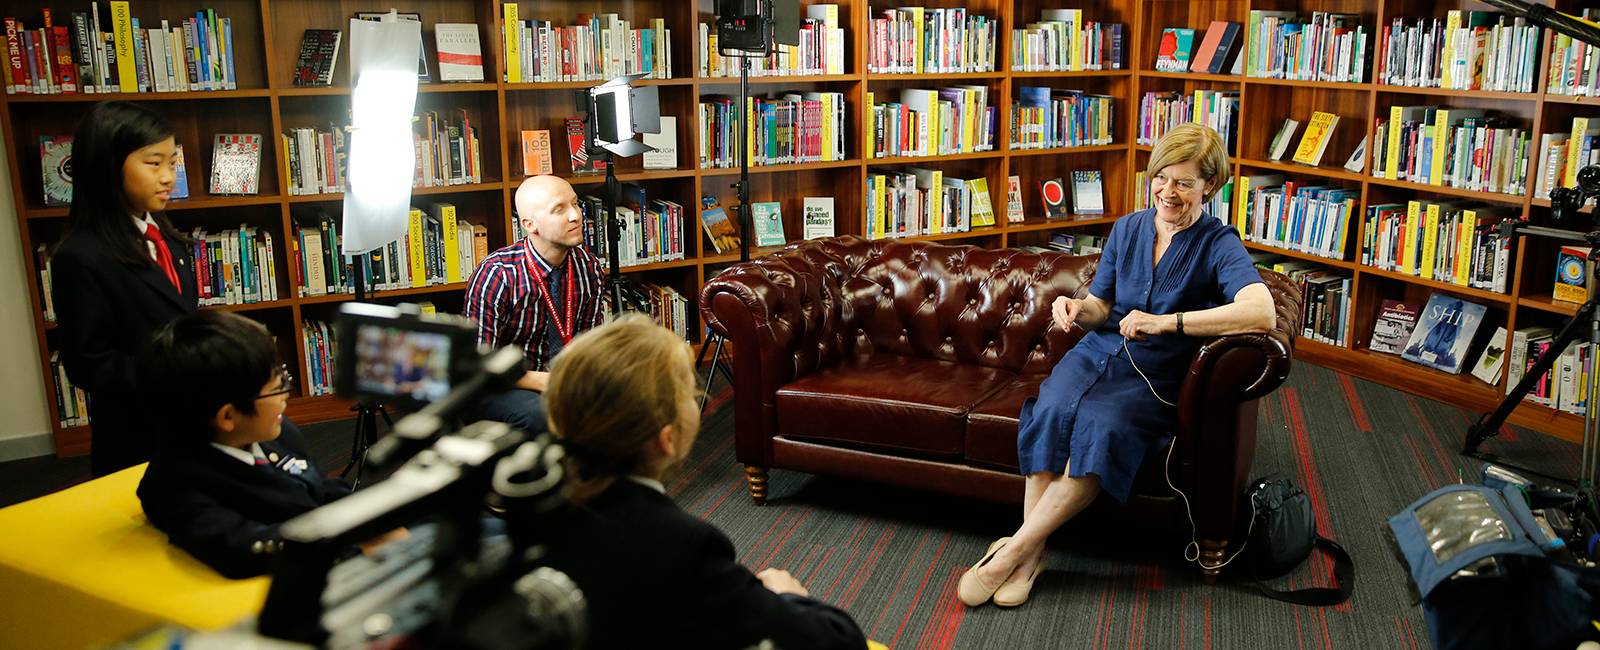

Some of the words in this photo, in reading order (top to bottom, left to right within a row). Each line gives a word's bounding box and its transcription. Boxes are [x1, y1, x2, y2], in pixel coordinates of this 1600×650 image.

[6, 20, 18, 40] PICK
[76, 16, 88, 45] BREAKING
[82, 46, 90, 63] NEWS
[118, 19, 128, 57] Philosophy
[9, 42, 20, 55] ME
[11, 56, 22, 69] UP
[1155, 59, 1188, 69] FEYNMAN
[541, 130, 550, 173] BILLION
[1406, 216, 1415, 248] Engineering
[1464, 226, 1472, 245] Military
[1382, 310, 1415, 322] Antibiotics
[1429, 304, 1475, 326] SHIP
